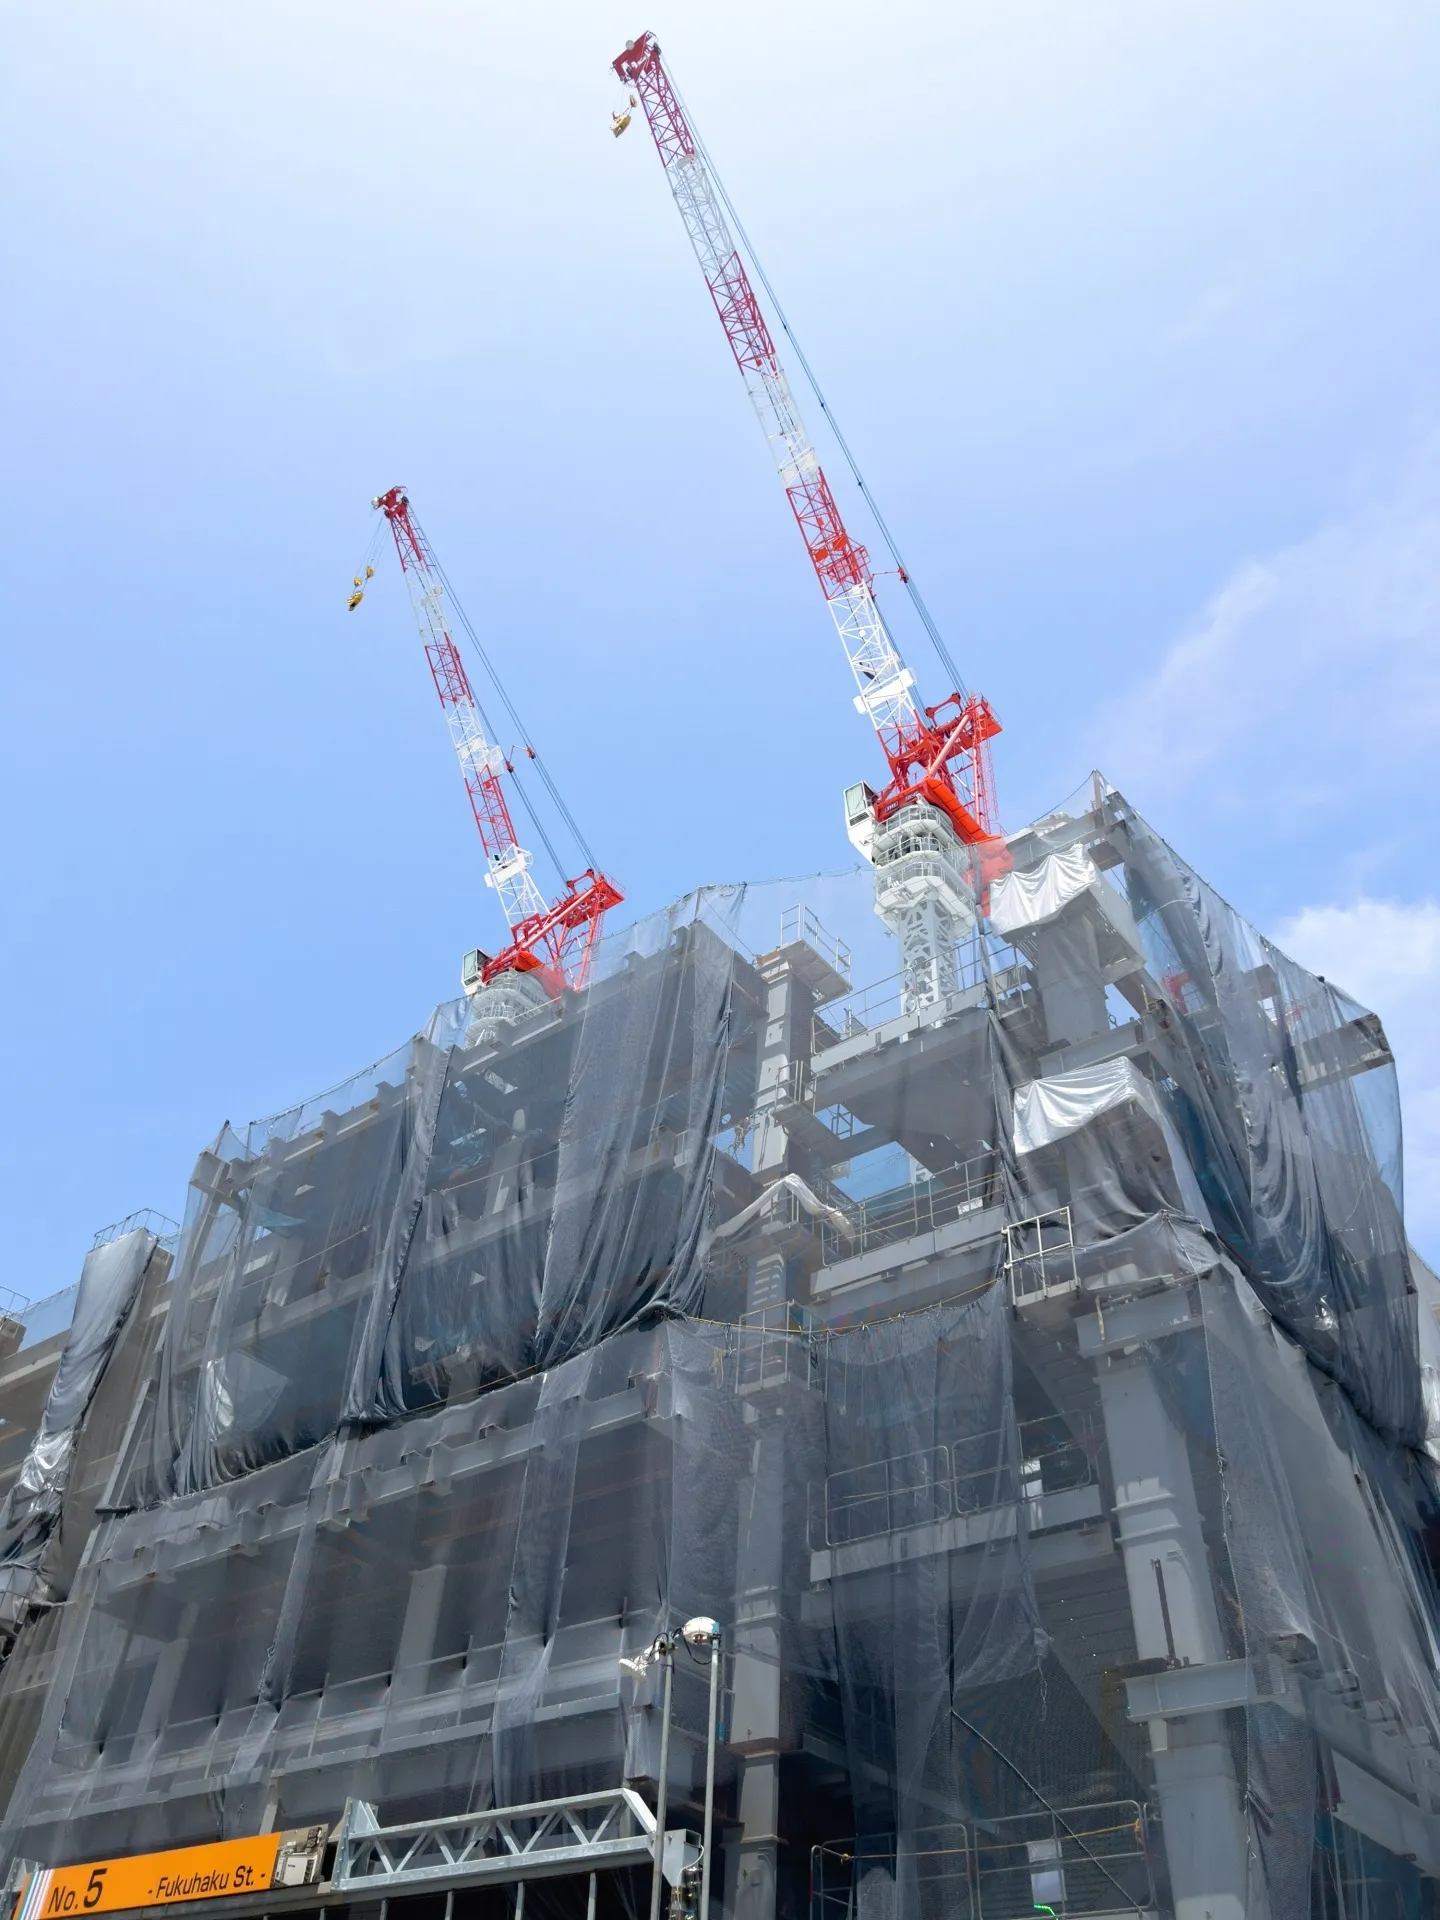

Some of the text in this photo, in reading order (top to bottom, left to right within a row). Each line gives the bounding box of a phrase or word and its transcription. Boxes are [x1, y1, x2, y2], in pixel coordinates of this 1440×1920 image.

[47, 1867, 108, 1914] No. 5
[156, 1869, 230, 1899] Fukuhaku
